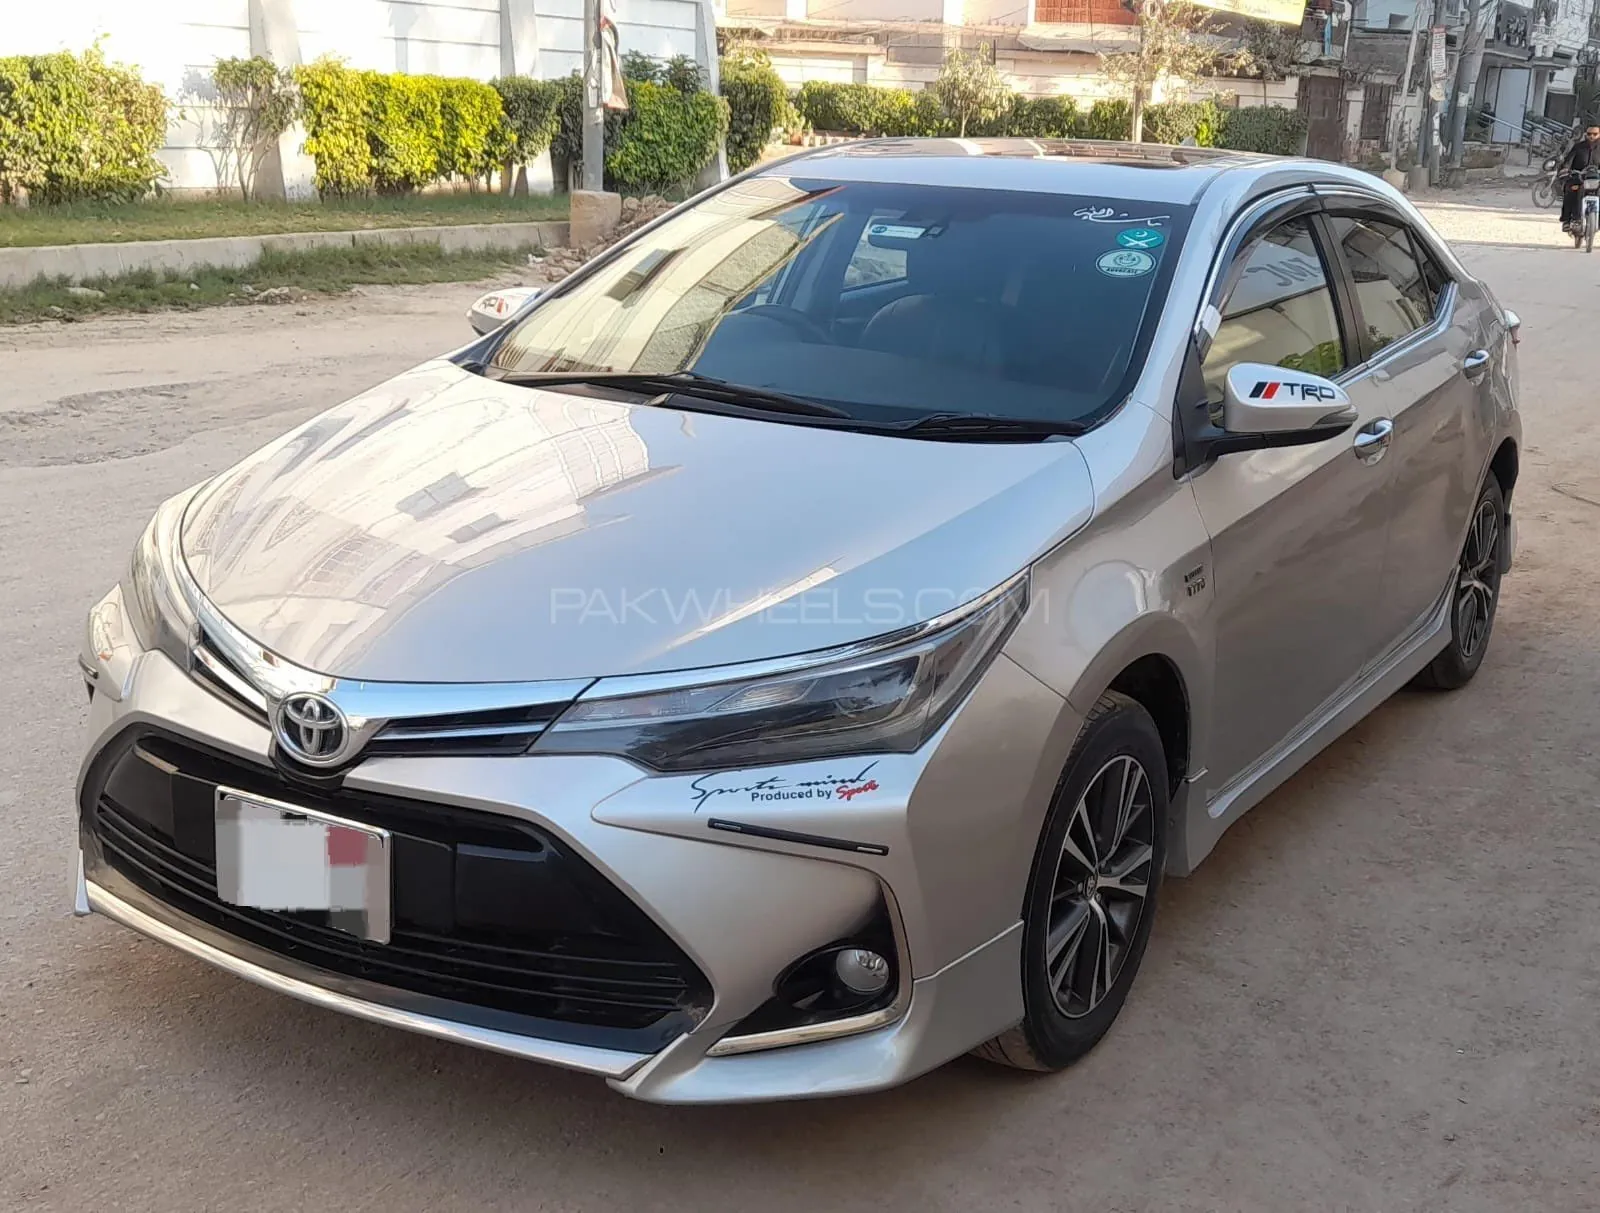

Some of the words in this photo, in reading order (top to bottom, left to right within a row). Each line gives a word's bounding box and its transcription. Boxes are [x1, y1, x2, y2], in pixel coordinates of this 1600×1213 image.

[1282, 382, 1336, 402] TRD
[796, 760, 880, 787] mind
[751, 788, 813, 802] Produced
[816, 788, 832, 799] by
